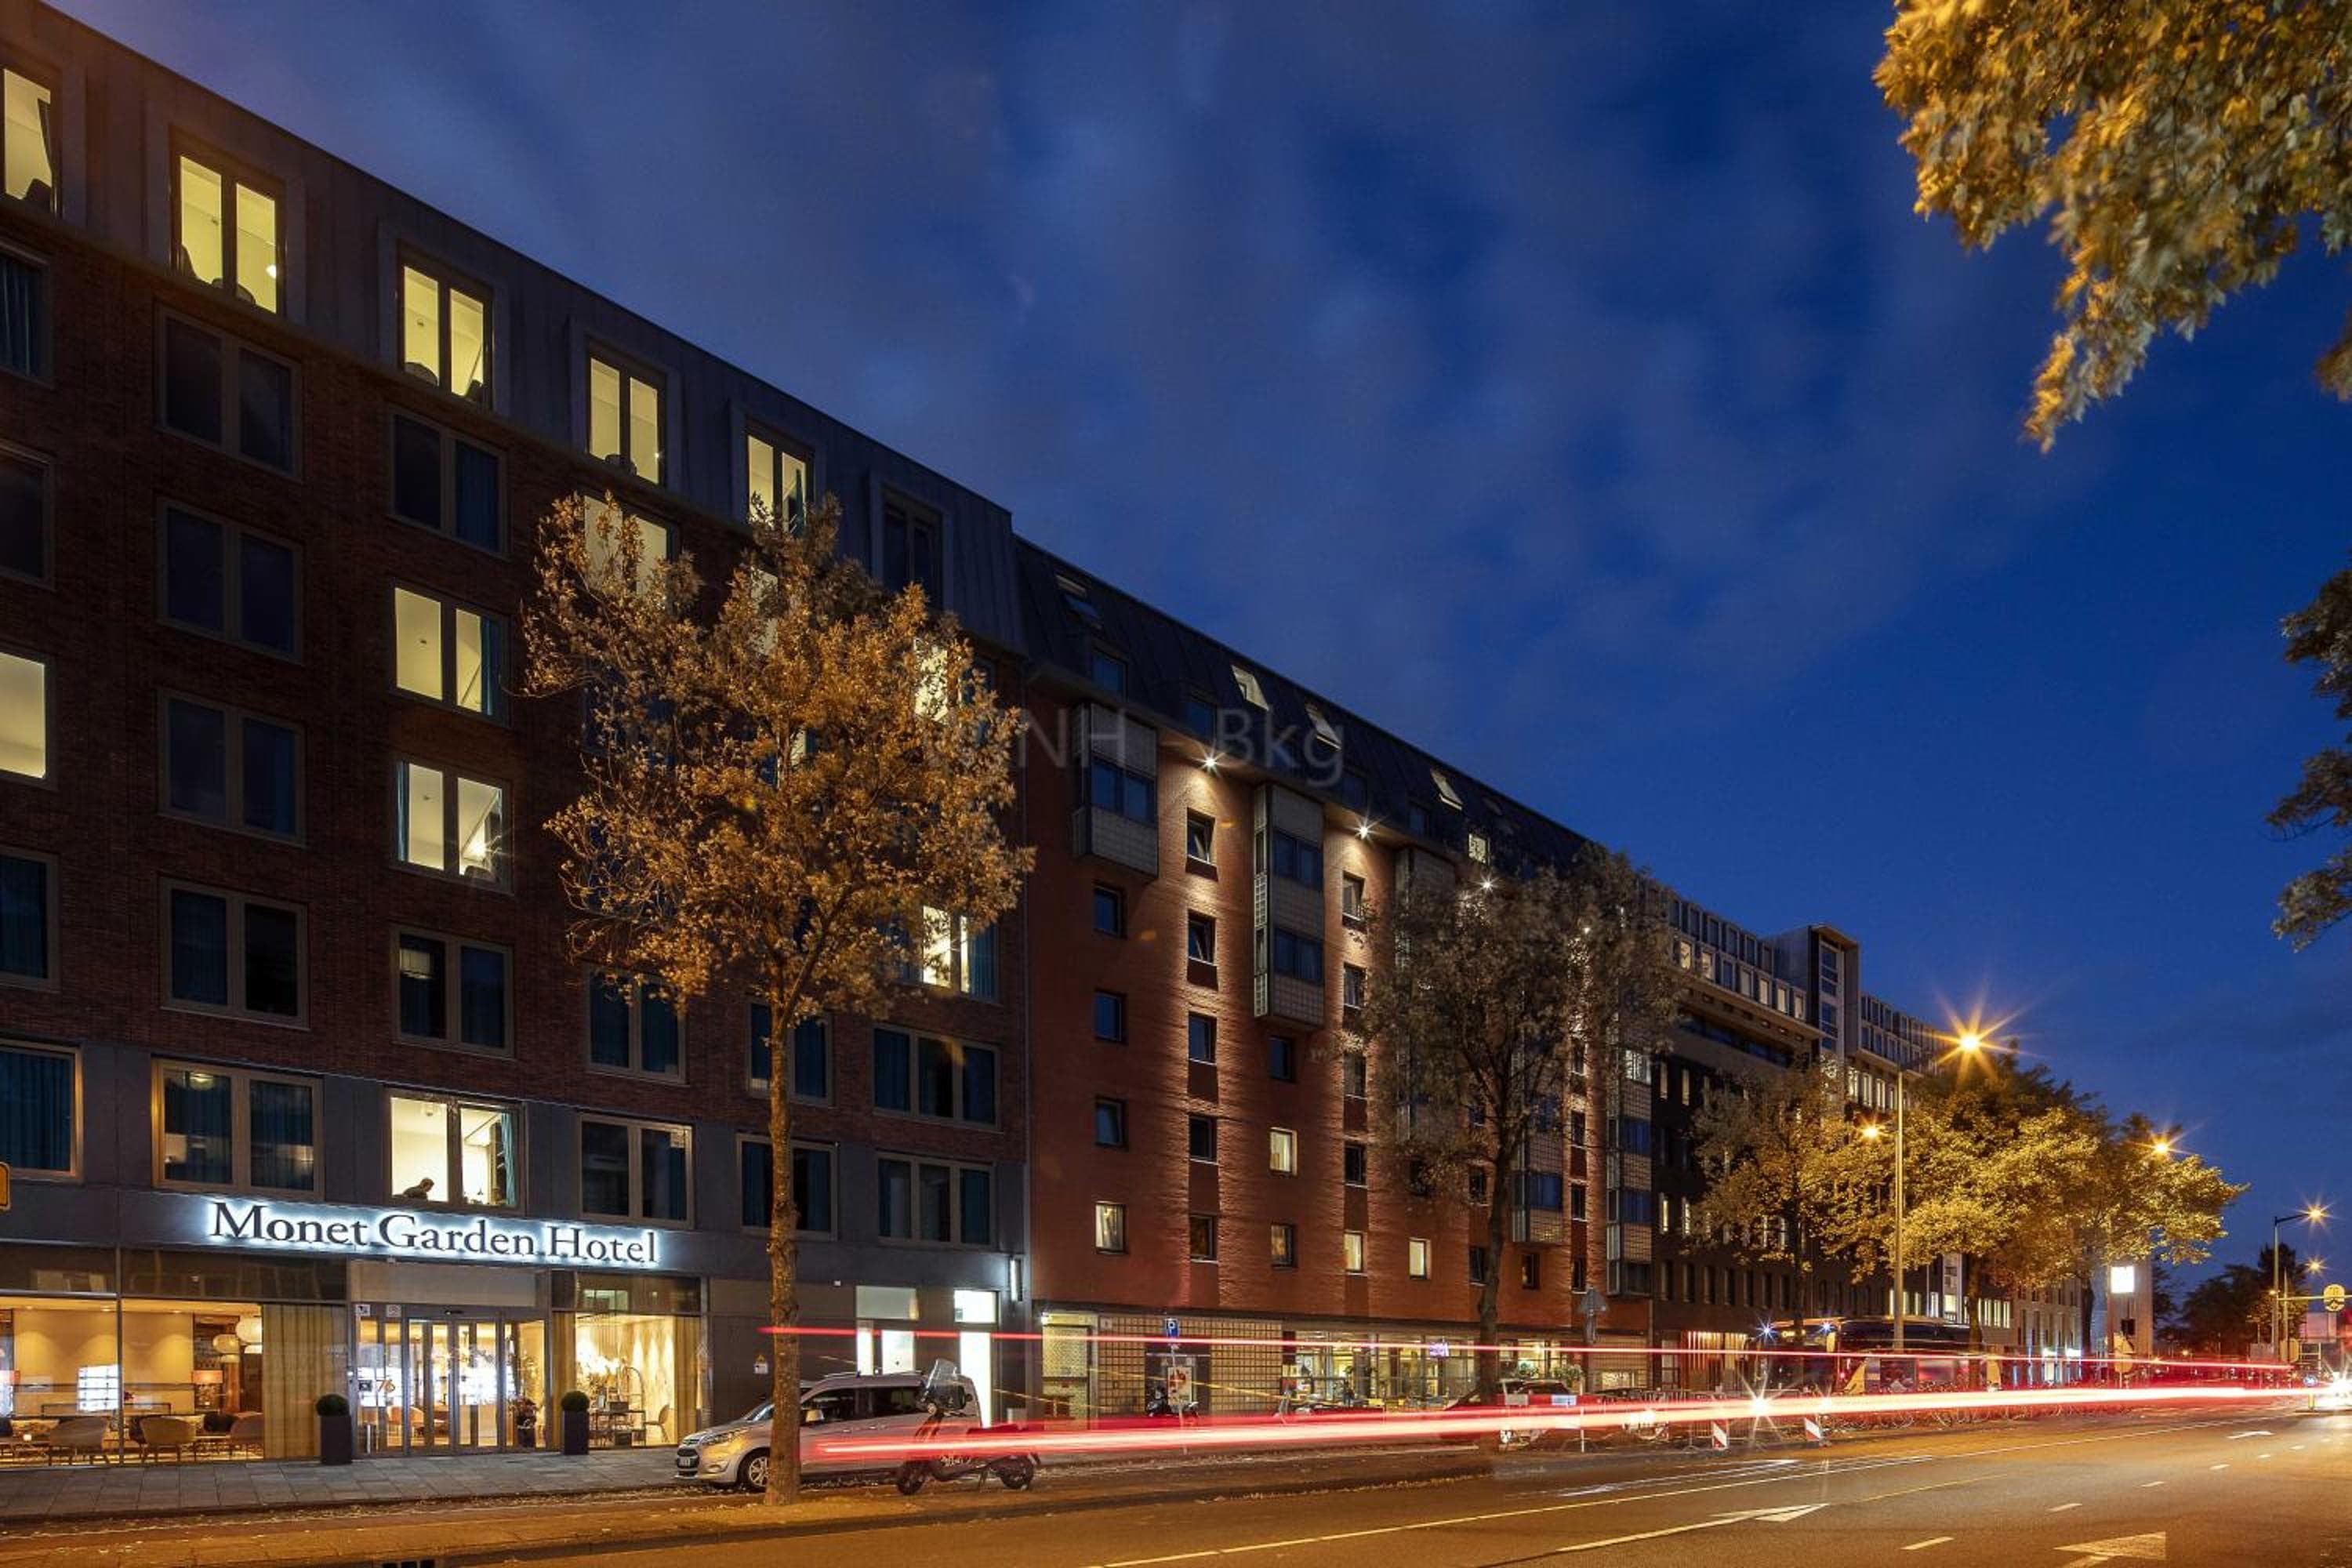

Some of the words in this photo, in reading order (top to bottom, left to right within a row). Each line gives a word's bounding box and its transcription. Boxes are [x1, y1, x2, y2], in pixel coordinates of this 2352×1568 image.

[210, 1202, 368, 1247] Monet
[379, 1214, 535, 1257] Garden
[547, 1224, 659, 1264] Hotel
